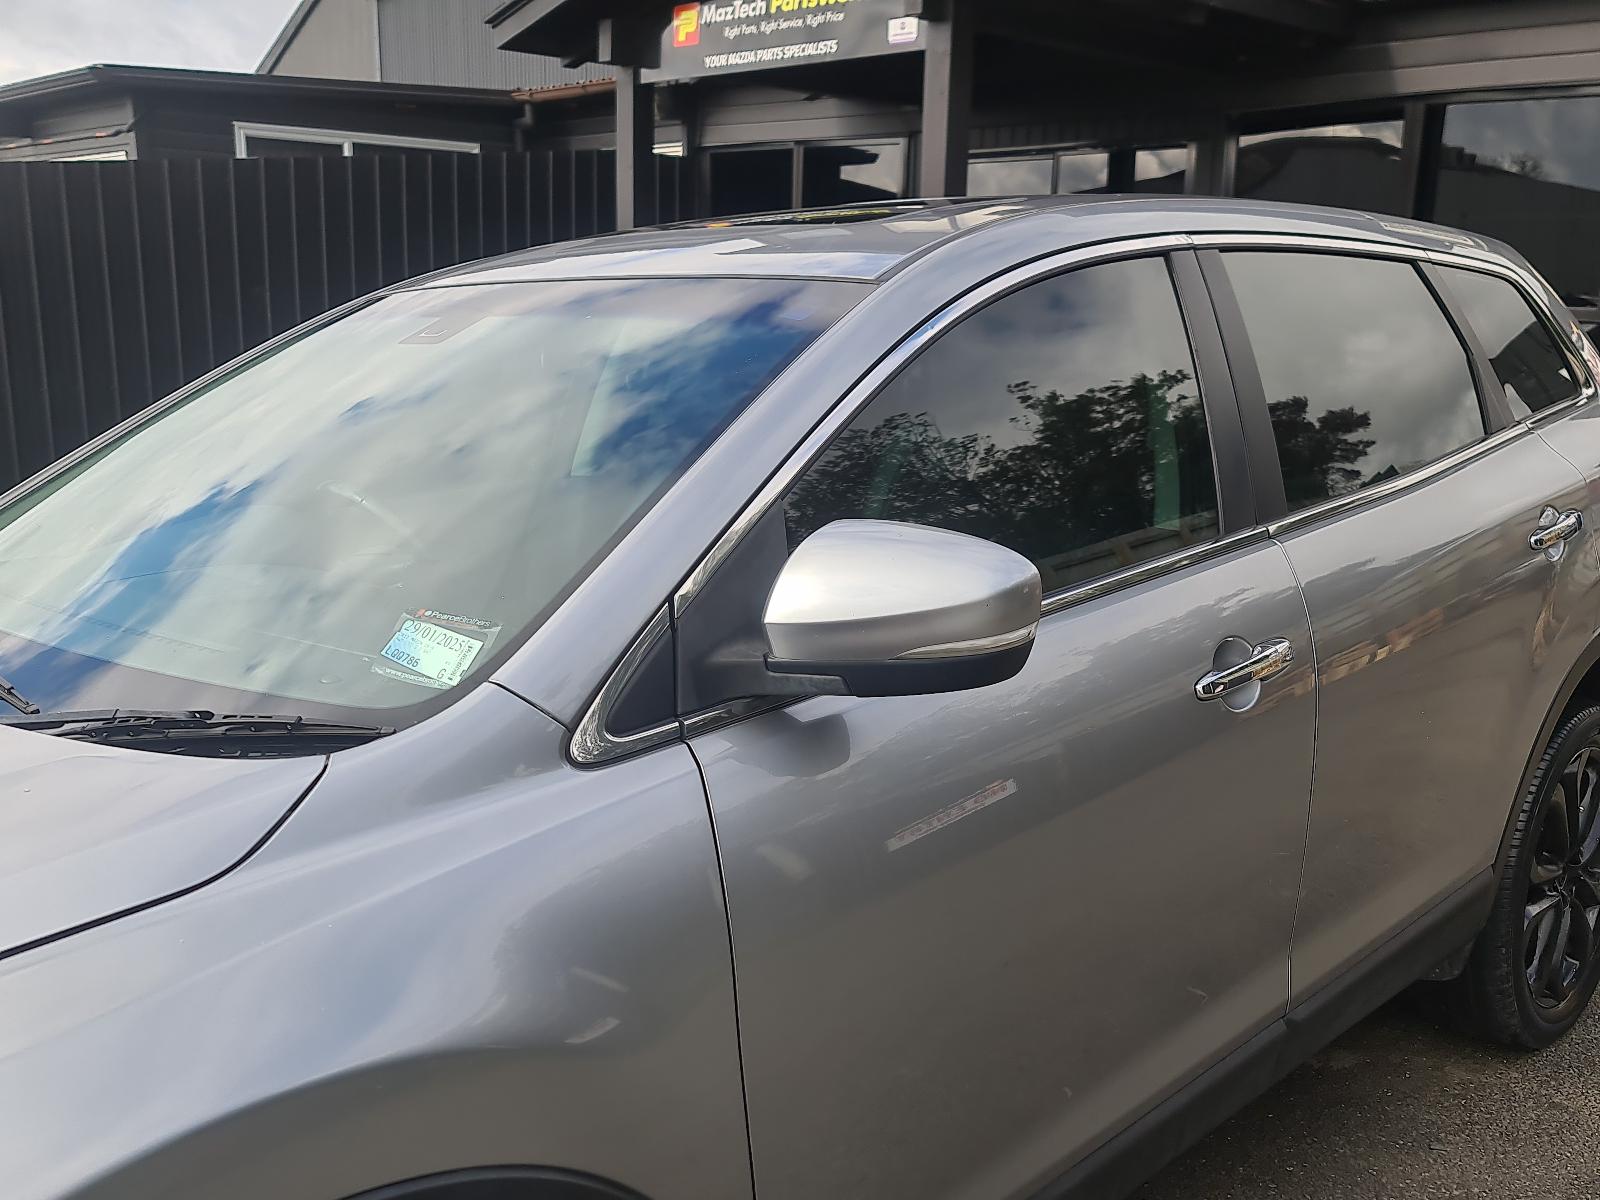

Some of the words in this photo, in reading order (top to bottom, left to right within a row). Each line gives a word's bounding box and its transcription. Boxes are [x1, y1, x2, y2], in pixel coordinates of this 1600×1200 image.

[701, 0, 766, 24] MazTech
[724, 25, 741, 39] Right
[760, 19, 778, 35] Right
[778, 17, 805, 30] Service,
[806, 12, 826, 27] Right
[826, 10, 845, 23] Price
[704, 53, 727, 68] YOUR
[727, 50, 756, 66] MAZDA
[755, 47, 784, 62] PARTS
[783, 39, 839, 59] SPECIALISTS
[403, 618, 463, 652] 29/01/2025
[436, 668, 447, 680] G
